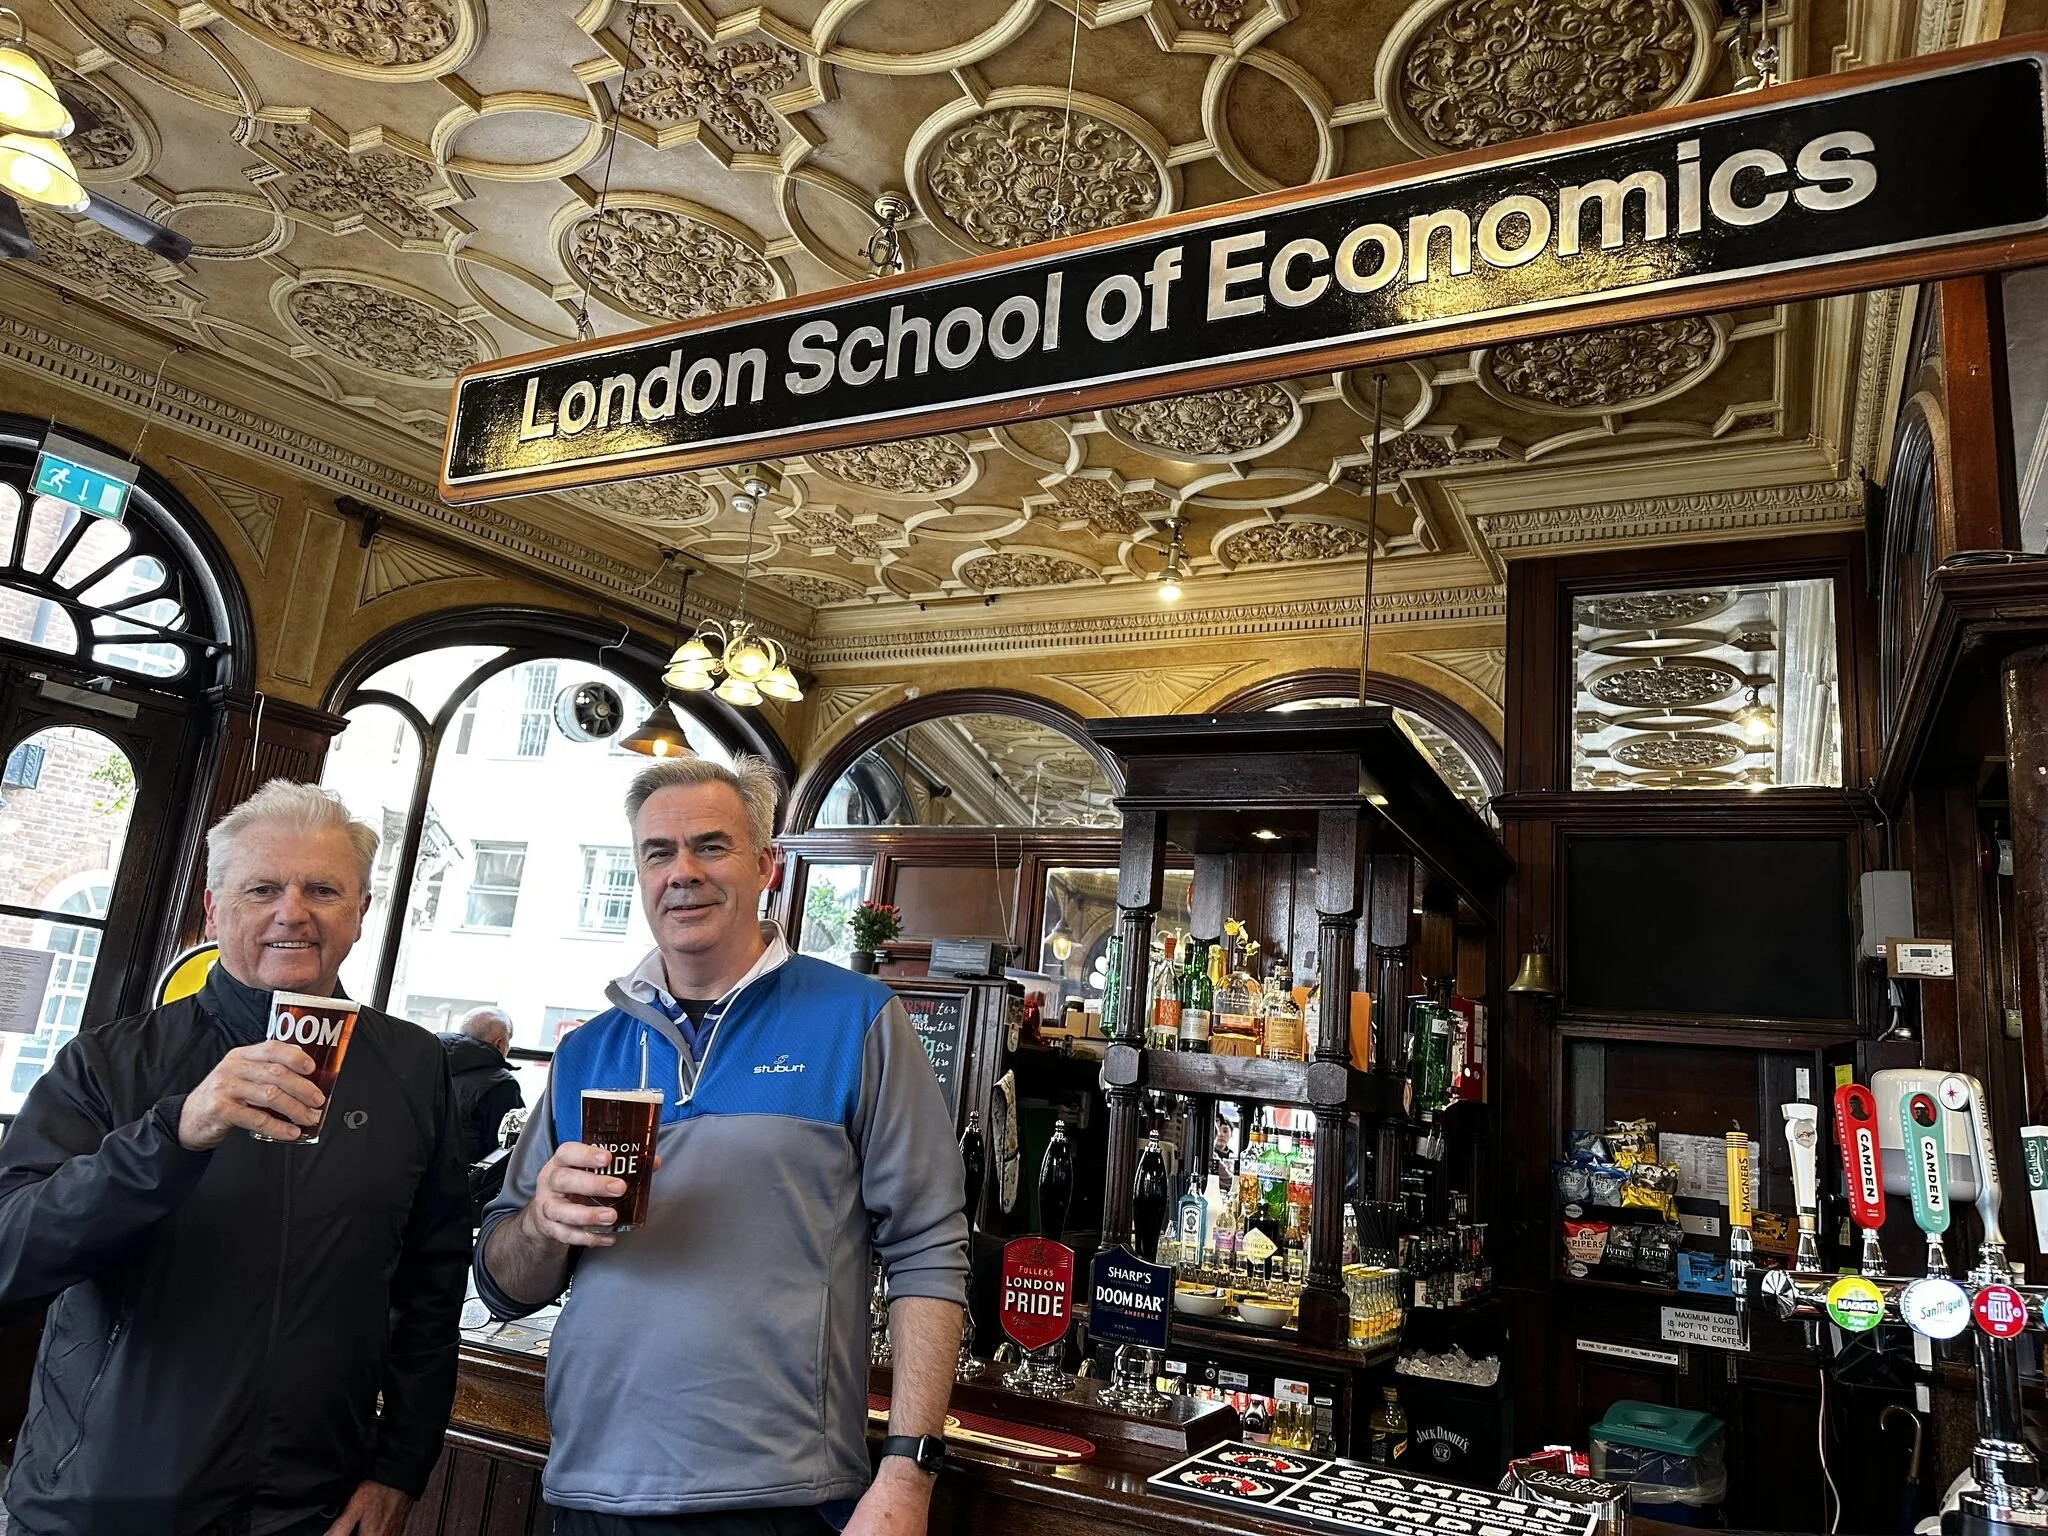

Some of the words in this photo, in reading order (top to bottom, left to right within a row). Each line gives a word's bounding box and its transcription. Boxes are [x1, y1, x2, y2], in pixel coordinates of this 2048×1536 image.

[519, 347, 769, 441] London
[784, 271, 1061, 395] School
[1086, 258, 1184, 342] of
[1206, 129, 1880, 322] Economics
[753, 1063, 806, 1074] stuburt
[1977, 1095, 1990, 1131] ARTOIS
[1860, 1133, 1876, 1198] CAMDEN
[1924, 1141, 1940, 1205] CAMDEN
[1987, 1148, 1998, 1184] STELLA
[2024, 1139, 2043, 1188] Carlsberg
[1738, 1157, 1750, 1213] MAGNERS
[1572, 1240, 1603, 1249] PIPERS
[1019, 1265, 1054, 1277] FULLER'S
[1107, 1266, 1152, 1284] SHARP'S
[1006, 1275, 1065, 1293] LONDON
[1096, 1285, 1134, 1307] DOOM
[1004, 1289, 1064, 1317] PRIDE
[1124, 1309, 1145, 1319] AMBER
[1146, 1313, 1160, 1321] ALE
[1667, 1319, 1675, 1327] IS
[1678, 1321, 1694, 1330] NOT
[1697, 1323, 1708, 1332] TO
[1674, 1311, 1710, 1322] MAXIMUM
[1713, 1315, 1734, 1325] LOAD
[1668, 1329, 1685, 1338] TWO
[1688, 1332, 1708, 1341] FULL
[1416, 1428, 1437, 1443] JACK
[1437, 1426, 1470, 1453] DANIEL'S
[1338, 1470, 1572, 1523] CAMDEN
